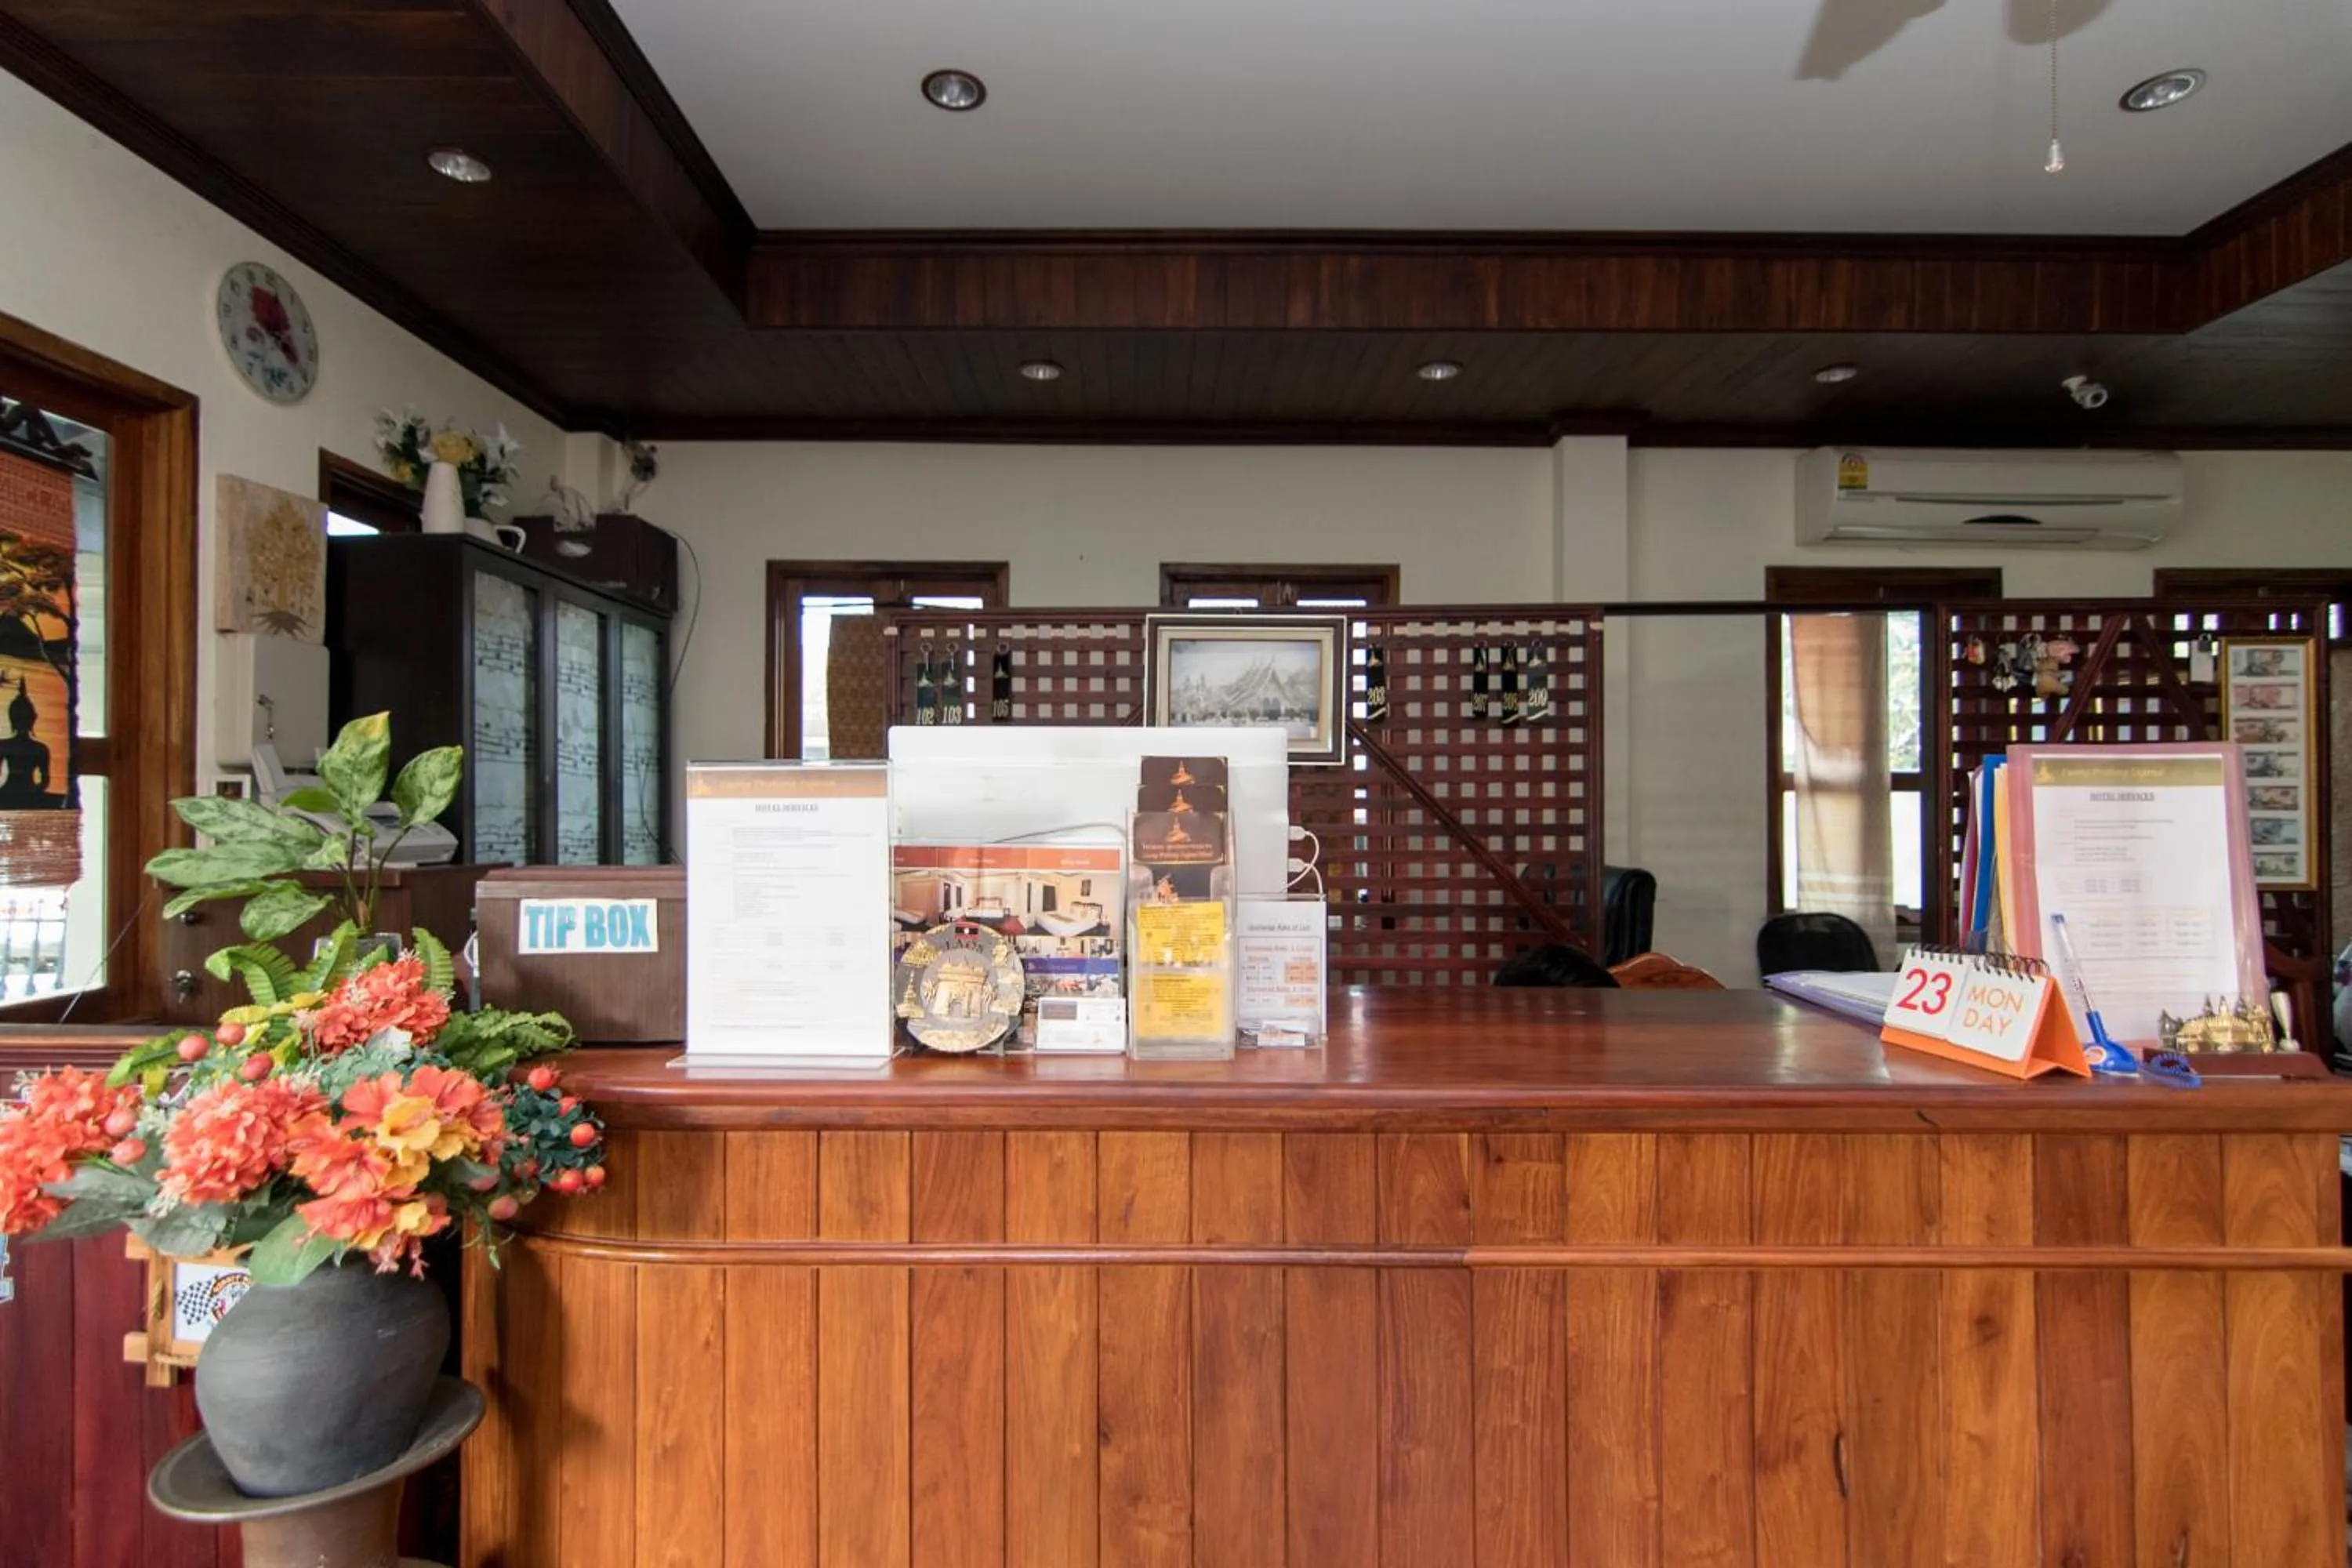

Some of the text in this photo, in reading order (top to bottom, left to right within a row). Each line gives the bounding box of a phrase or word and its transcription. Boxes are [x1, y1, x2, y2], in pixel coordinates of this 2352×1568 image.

[942, 706, 962, 724] 103
[524, 904, 651, 949] TIP BOX
[1896, 967, 1952, 1014] 23
[1968, 985, 2024, 1014] MON
[1964, 1008, 2013, 1036] DAY
